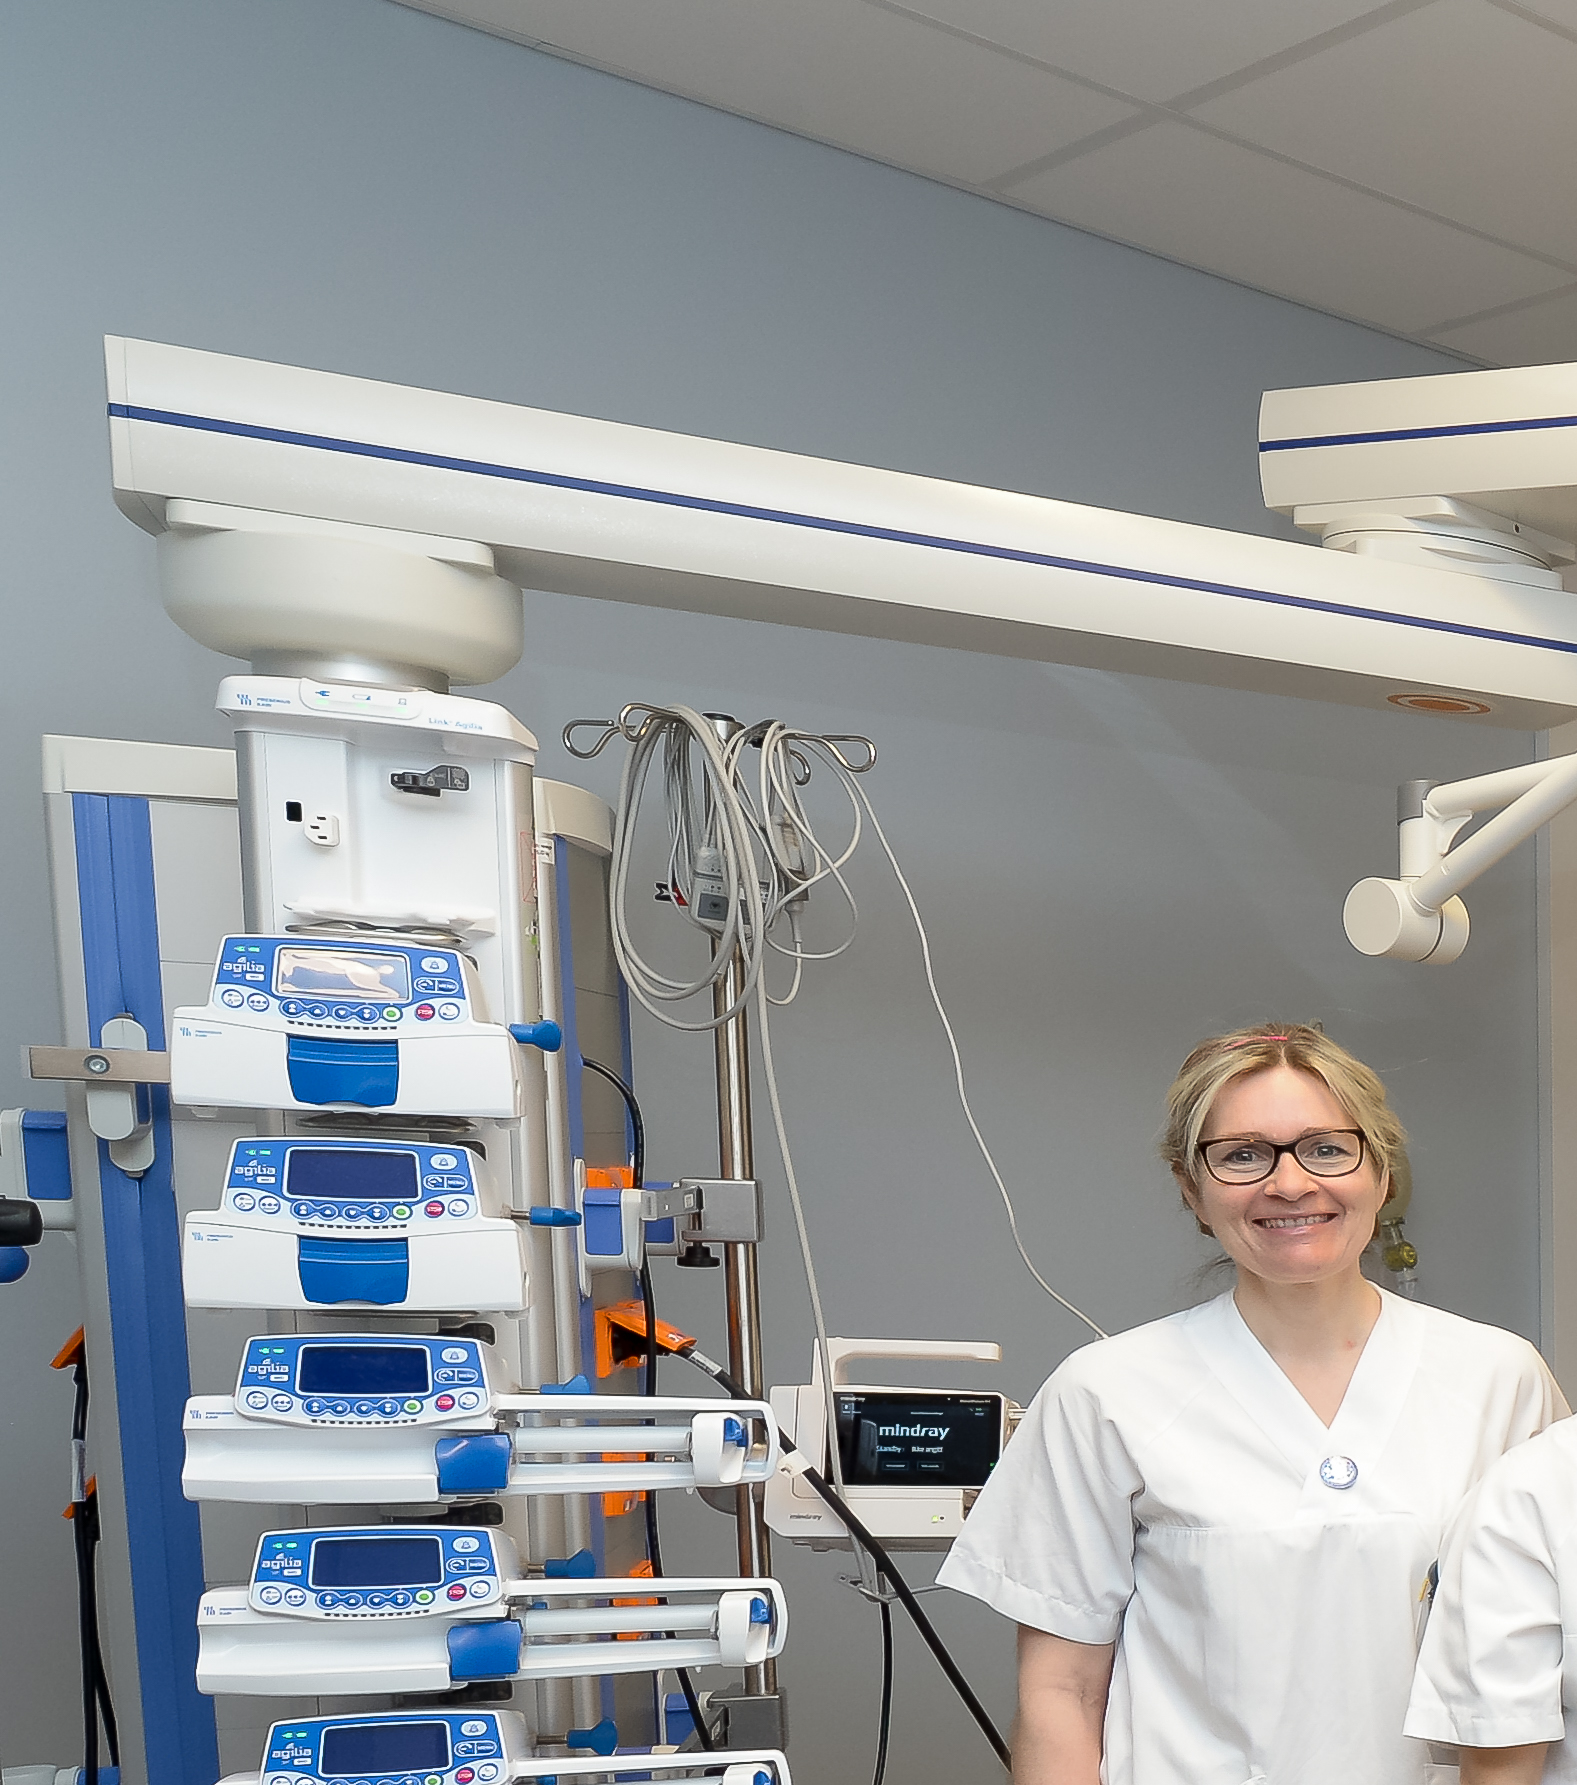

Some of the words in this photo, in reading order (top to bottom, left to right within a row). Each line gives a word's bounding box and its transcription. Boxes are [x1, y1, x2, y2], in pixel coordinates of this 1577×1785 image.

[223, 959, 265, 976] agilia
[235, 1163, 277, 1178] agilia
[248, 1362, 290, 1377] agilia
[879, 1423, 950, 1441] mindray
[262, 1556, 303, 1571] agilia
[272, 1745, 312, 1760] agilia
